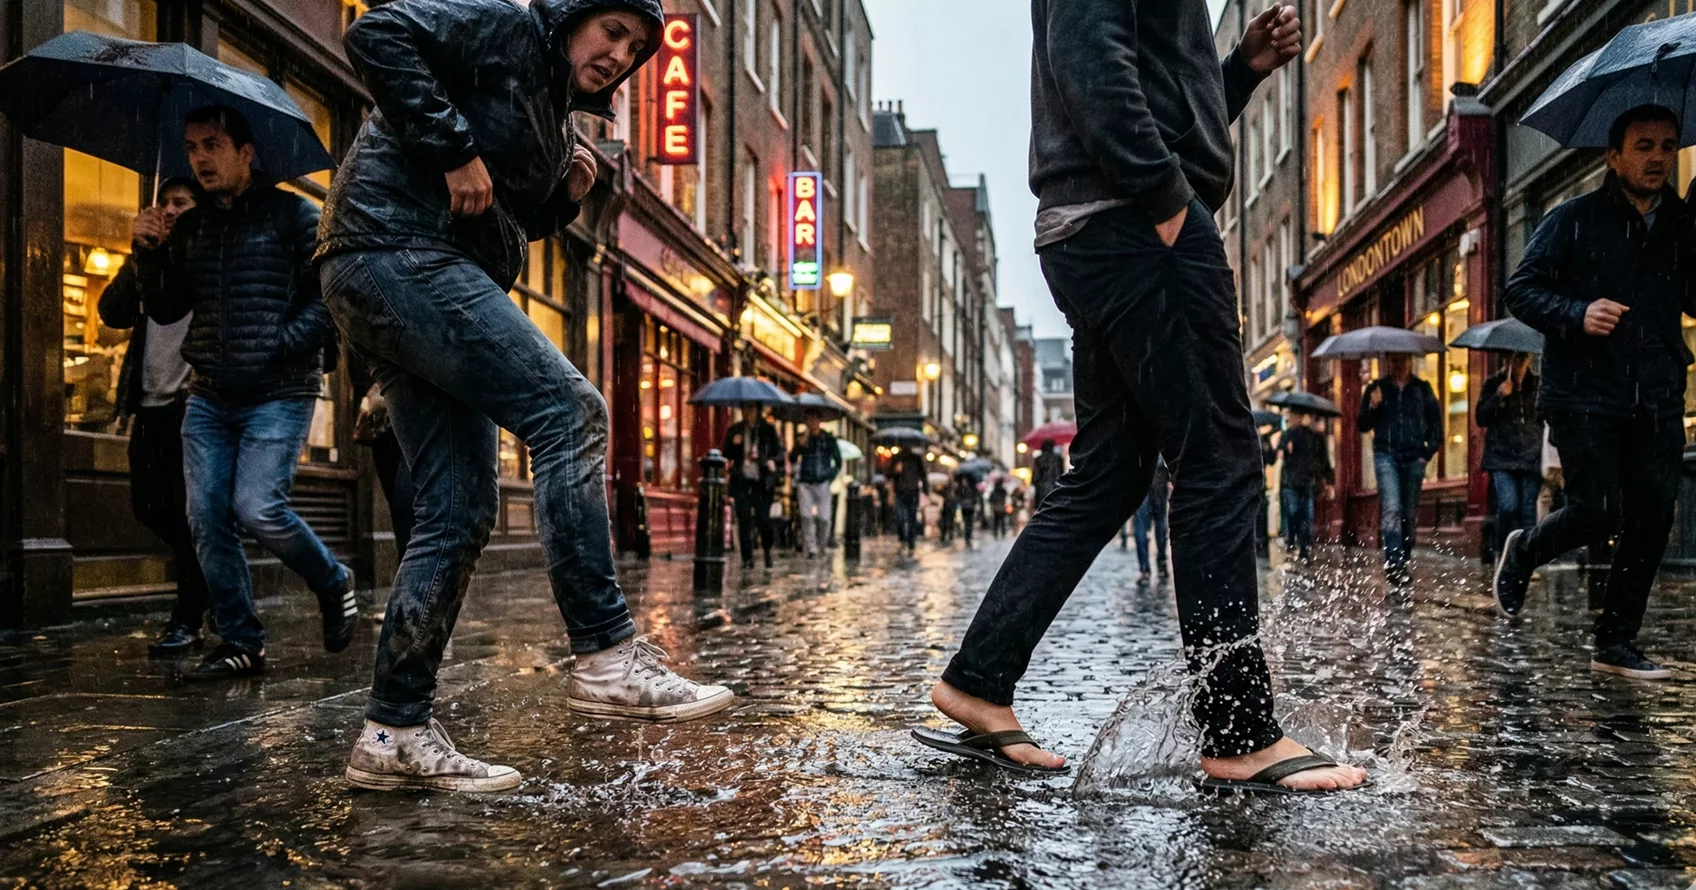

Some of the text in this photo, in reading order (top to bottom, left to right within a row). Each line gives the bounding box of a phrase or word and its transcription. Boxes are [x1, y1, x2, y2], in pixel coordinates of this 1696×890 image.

[664, 21, 689, 155] CAFE
[795, 178, 815, 245] BAR
[1338, 206, 1424, 297] LONDONTOWN
